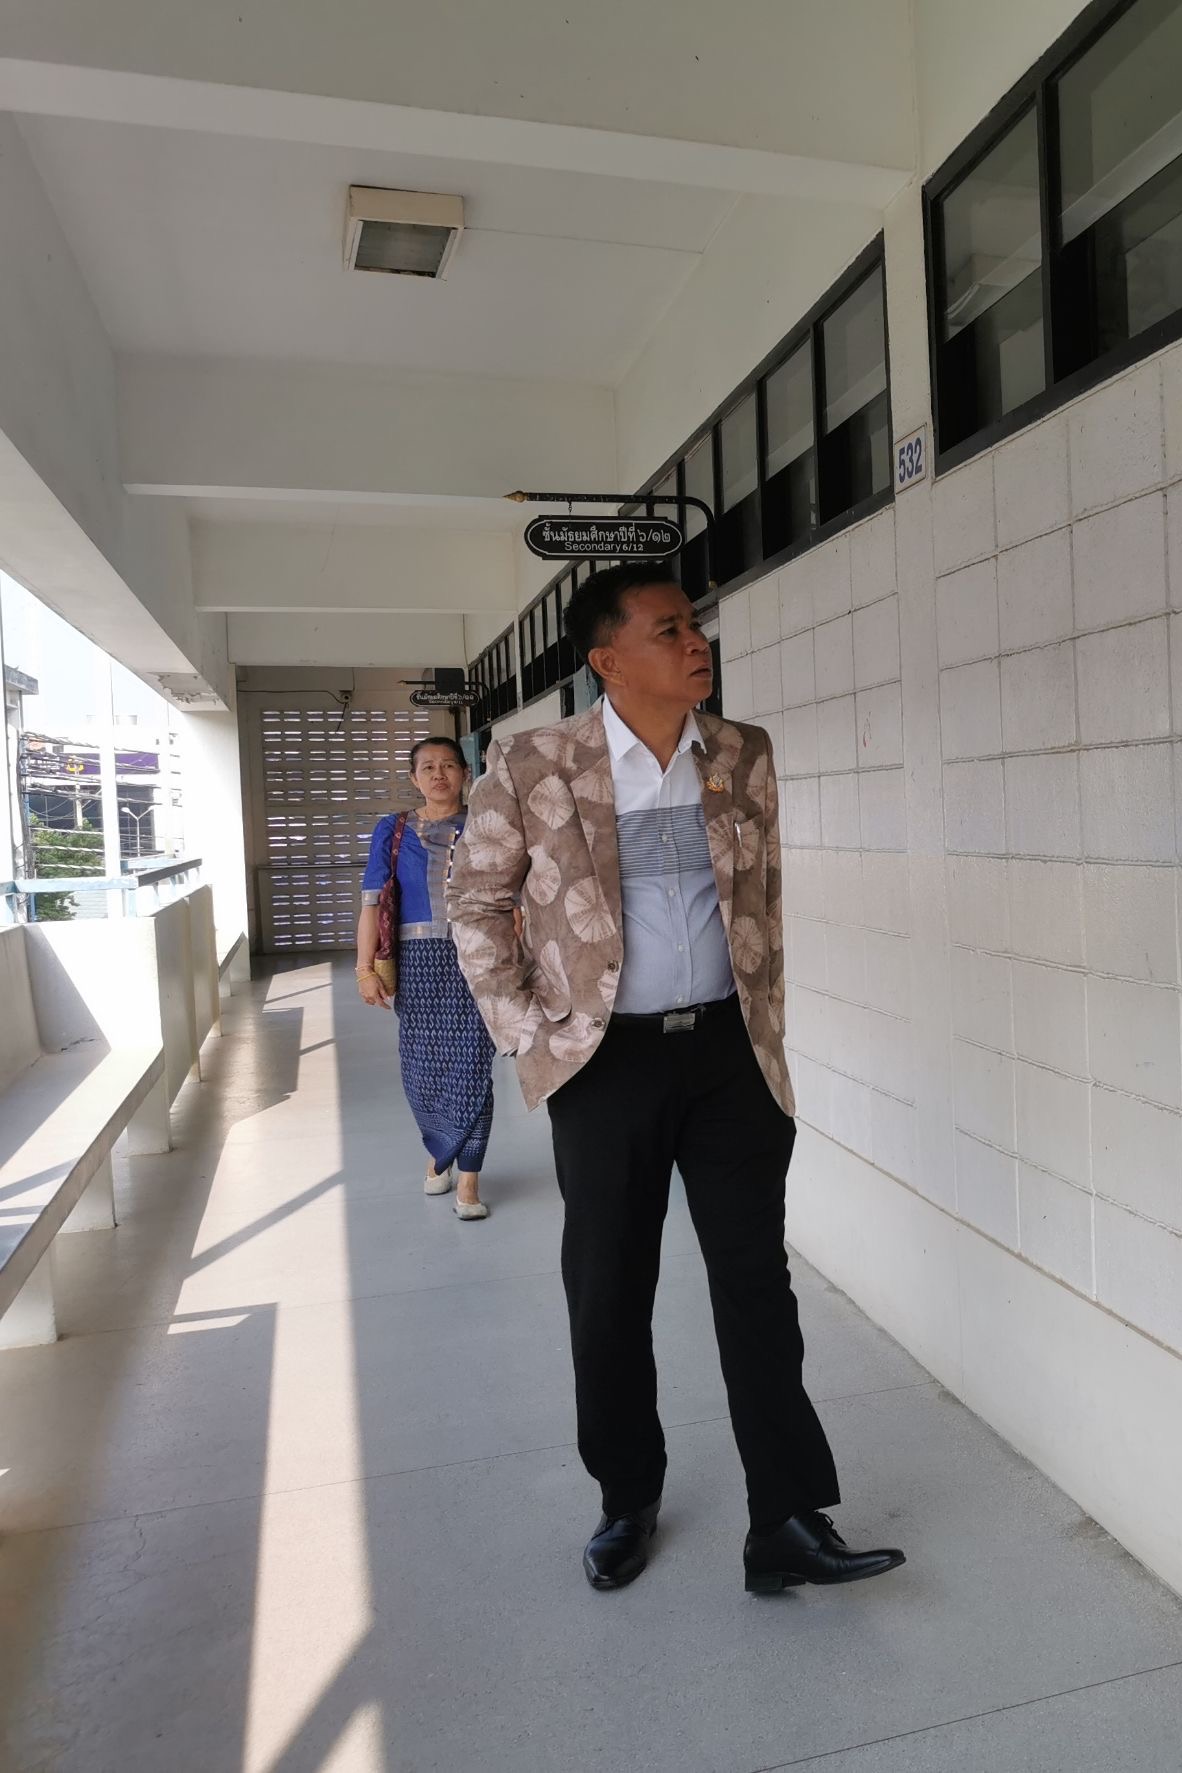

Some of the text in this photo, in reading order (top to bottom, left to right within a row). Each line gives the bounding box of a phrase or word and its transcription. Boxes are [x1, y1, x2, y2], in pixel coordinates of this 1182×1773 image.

[898, 436, 923, 484] 532
[564, 541, 644, 553] Secondary 6/12
